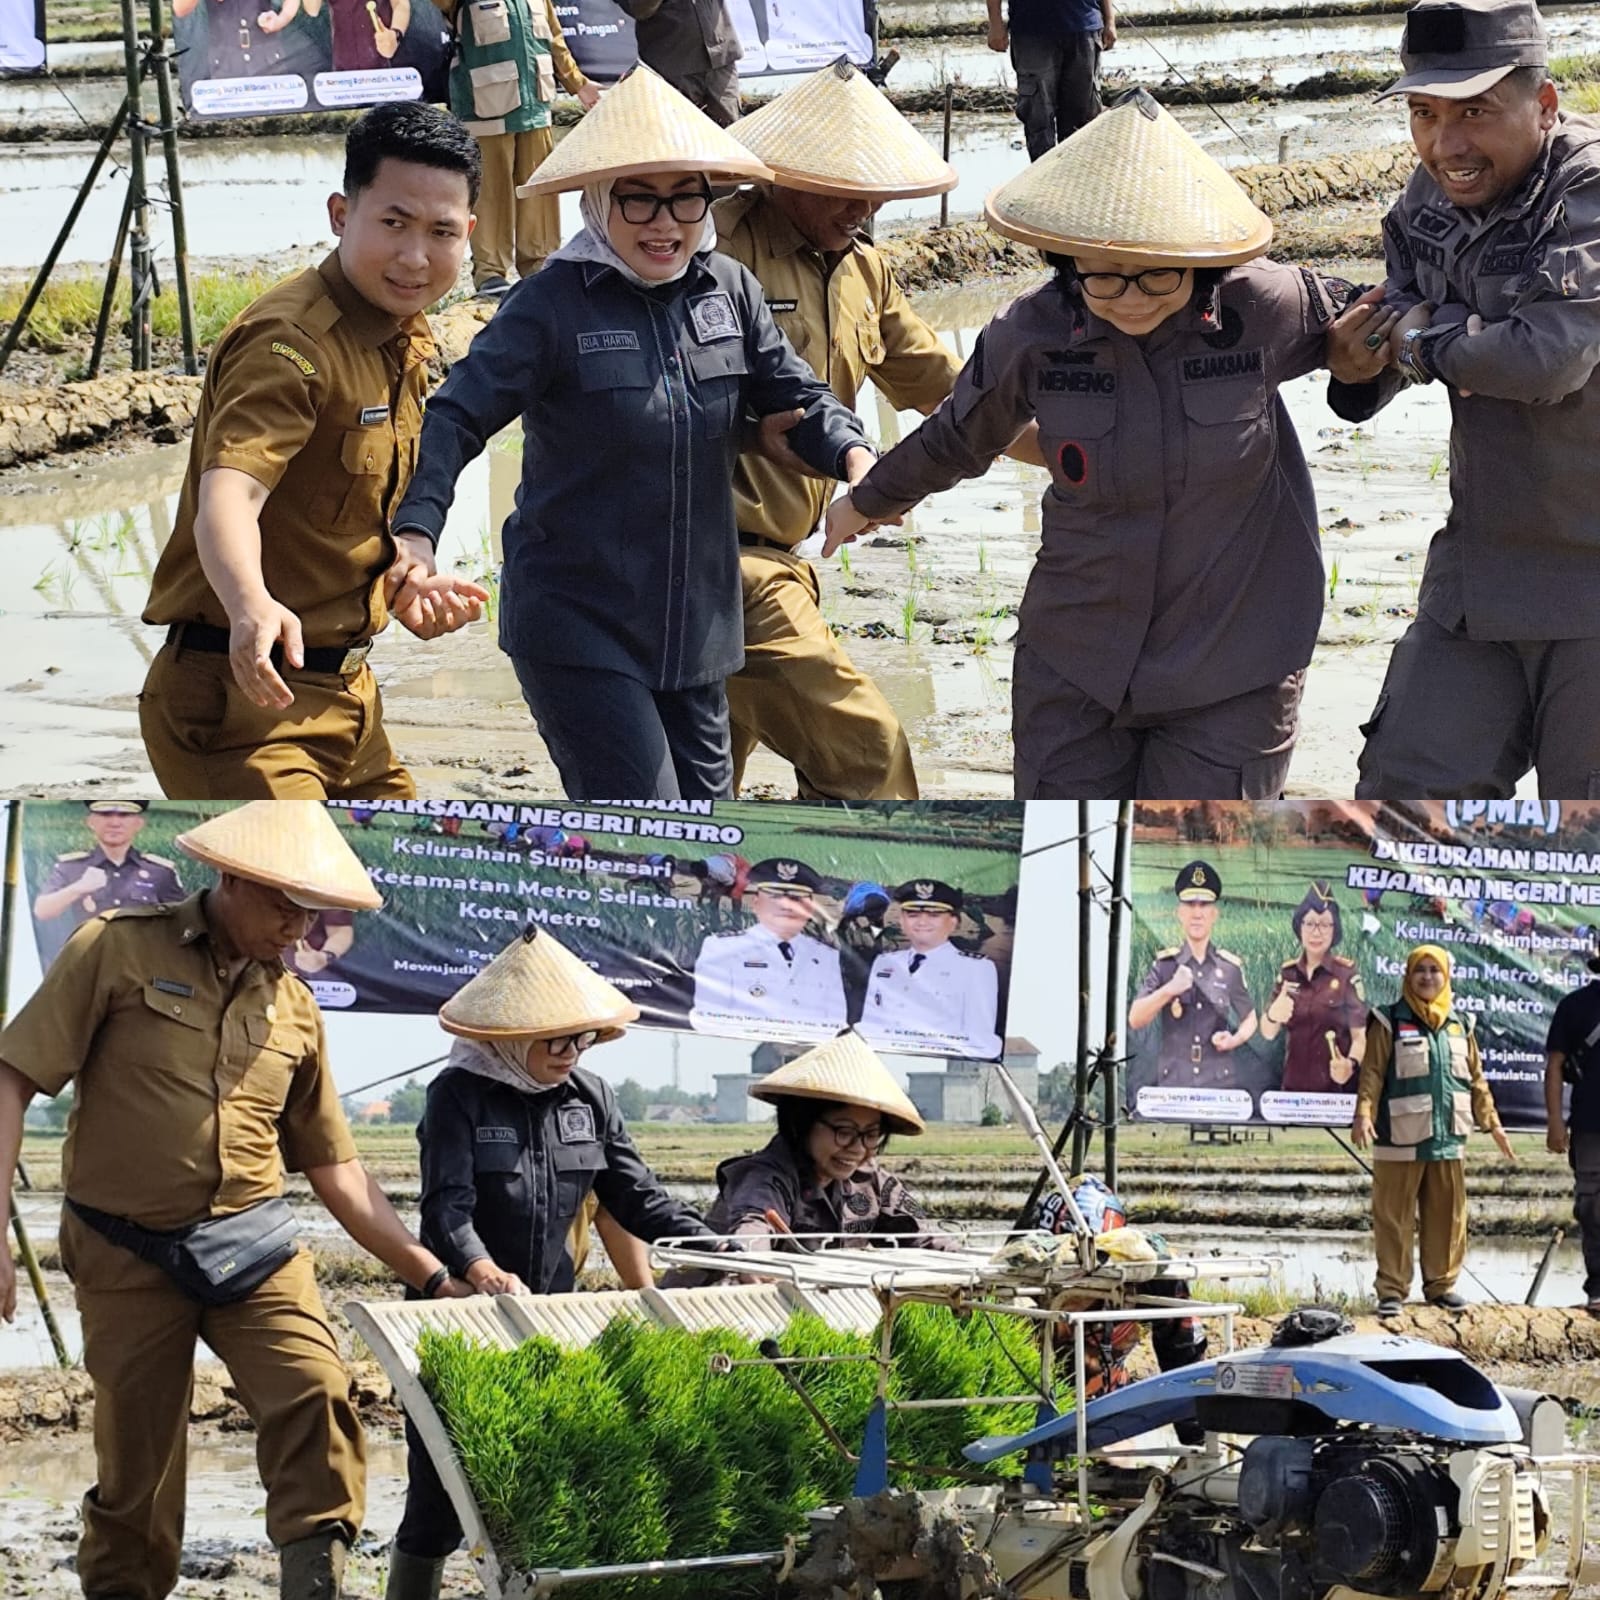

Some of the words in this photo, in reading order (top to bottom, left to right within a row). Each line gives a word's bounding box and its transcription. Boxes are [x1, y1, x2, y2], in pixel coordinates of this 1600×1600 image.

[578, 23, 618, 37] Pangan
[582, 336, 599, 350] RIA
[1038, 369, 1116, 394] NENENG
[590, 800, 713, 816] AAN
[520, 807, 635, 836] NEGERI
[639, 817, 743, 846] METRO
[393, 837, 521, 864] Kelurahan
[529, 849, 672, 878] Sumbersari
[1398, 843, 1530, 870] KELURAHAN
[1534, 851, 1600, 876] BINAA
[367, 866, 510, 894] Kecamatan
[517, 880, 591, 900] Metro
[599, 887, 692, 910] Selatan
[1485, 879, 1567, 905] NEGERI
[1570, 884, 1600, 906] ME
[459, 901, 519, 922] Kota
[526, 907, 601, 928] Metro
[1395, 921, 1490, 945] Kelurahan
[1493, 930, 1594, 951] Sumbersari
[468, 949, 500, 962] Pet
[394, 960, 478, 976] Mewujudk
[1484, 963, 1539, 984] Metro
[1543, 967, 1590, 987] Selat
[604, 977, 653, 989] angan
[1490, 994, 1544, 1014] Metro
[1489, 1049, 1545, 1064] Sejahtera
[1482, 1068, 1538, 1082] edaulatan
